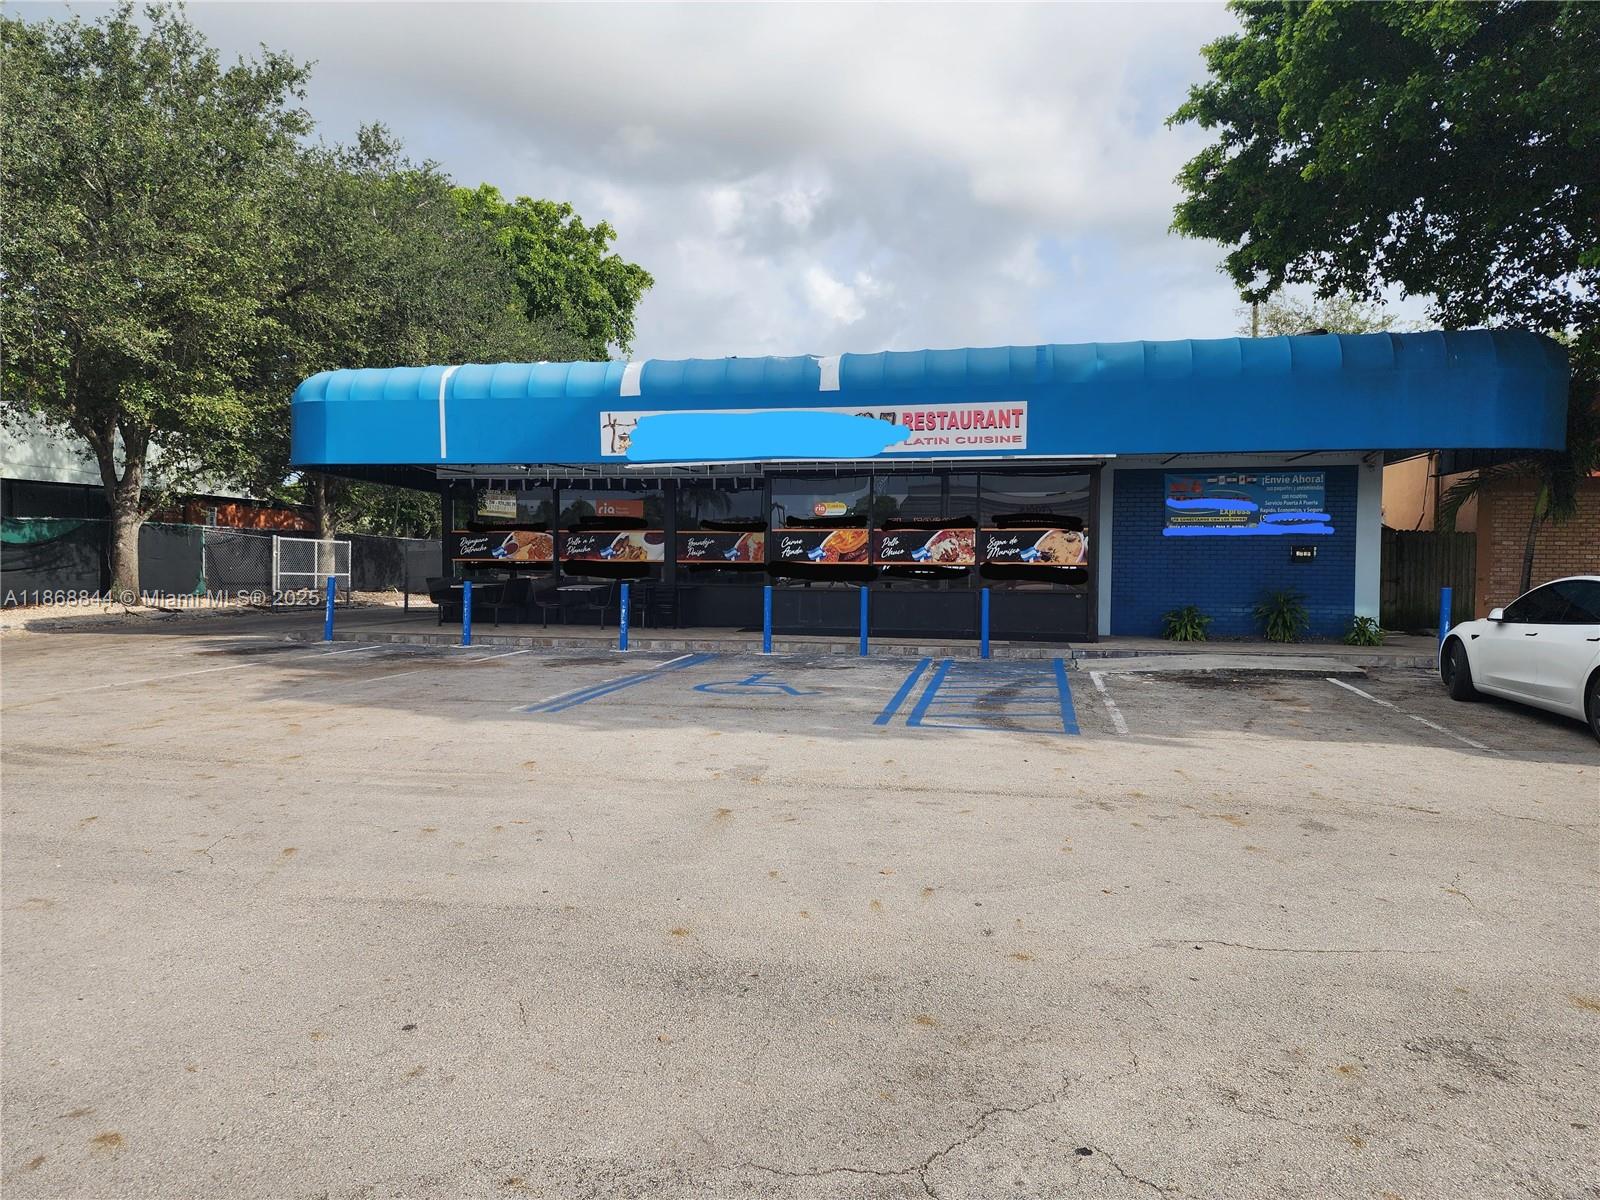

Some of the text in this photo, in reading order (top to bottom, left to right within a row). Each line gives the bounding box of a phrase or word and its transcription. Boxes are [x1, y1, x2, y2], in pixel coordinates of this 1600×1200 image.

[902, 409, 1024, 431] RESTAURANT
[903, 435, 1023, 446] LATIN CUISINE
[1292, 474, 1324, 484] Ahora!
[598, 503, 615, 514] ria
[566, 537, 581, 547] Pollo
[781, 536, 803, 548] Carne
[881, 536, 900, 549] Pollo
[1009, 536, 1018, 545] de
